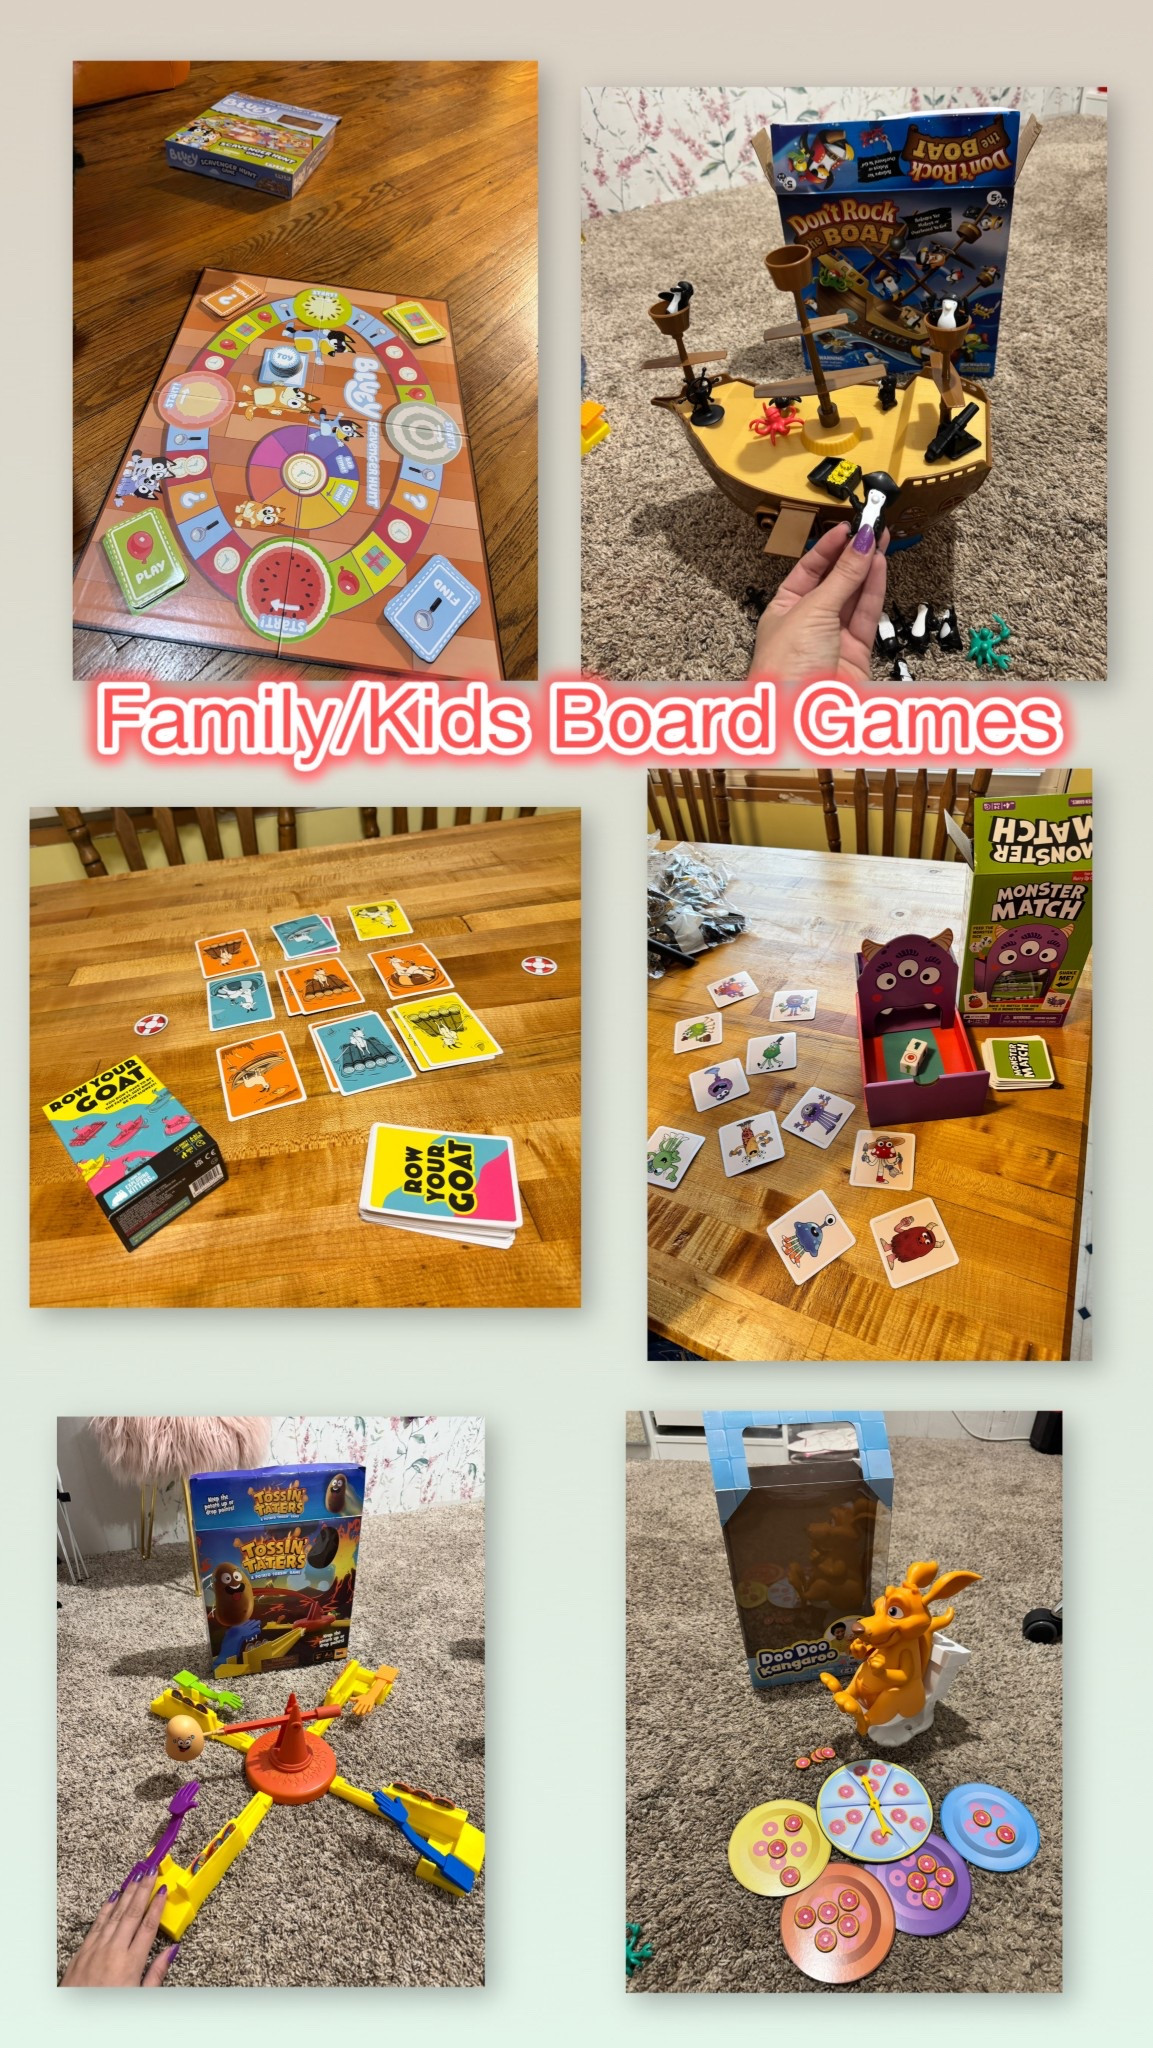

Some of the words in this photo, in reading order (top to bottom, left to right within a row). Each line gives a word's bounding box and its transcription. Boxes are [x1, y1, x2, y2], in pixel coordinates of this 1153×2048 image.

[912, 137, 980, 162] BOAT
[981, 132, 1001, 149] the
[271, 152, 296, 164] HUNT
[238, 167, 257, 179] HUNT
[822, 223, 895, 247] BOAT
[276, 352, 294, 361] TOY
[135, 559, 166, 584] PLAY
[433, 578, 461, 607] FIND
[991, 815, 1092, 845] MATCH
[993, 842, 1092, 866] MONSTER
[996, 882, 1086, 903] MONSTER
[991, 898, 1083, 922] MATCH
[1008, 1043, 1022, 1077] MONSTER
[1016, 1042, 1035, 1078] MATCH
[49, 1084, 89, 1113] ROW
[88, 1059, 138, 1088] YOUR
[75, 1065, 146, 1113] GOAT
[404, 1146, 423, 1193] ROW
[426, 1145, 445, 1202] YOUR
[448, 1139, 475, 1212] GOAT
[127, 1175, 153, 1194] KITTENS
[254, 1489, 306, 1504] TOSSIN'
[254, 1502, 304, 1516] TATERS
[241, 1539, 308, 1559] TOSSIN'
[243, 1554, 306, 1574] TATERS
[760, 1650, 793, 1665] Doo
[795, 1641, 829, 1657] Doo
[760, 1650, 837, 1677] Kangaroo
